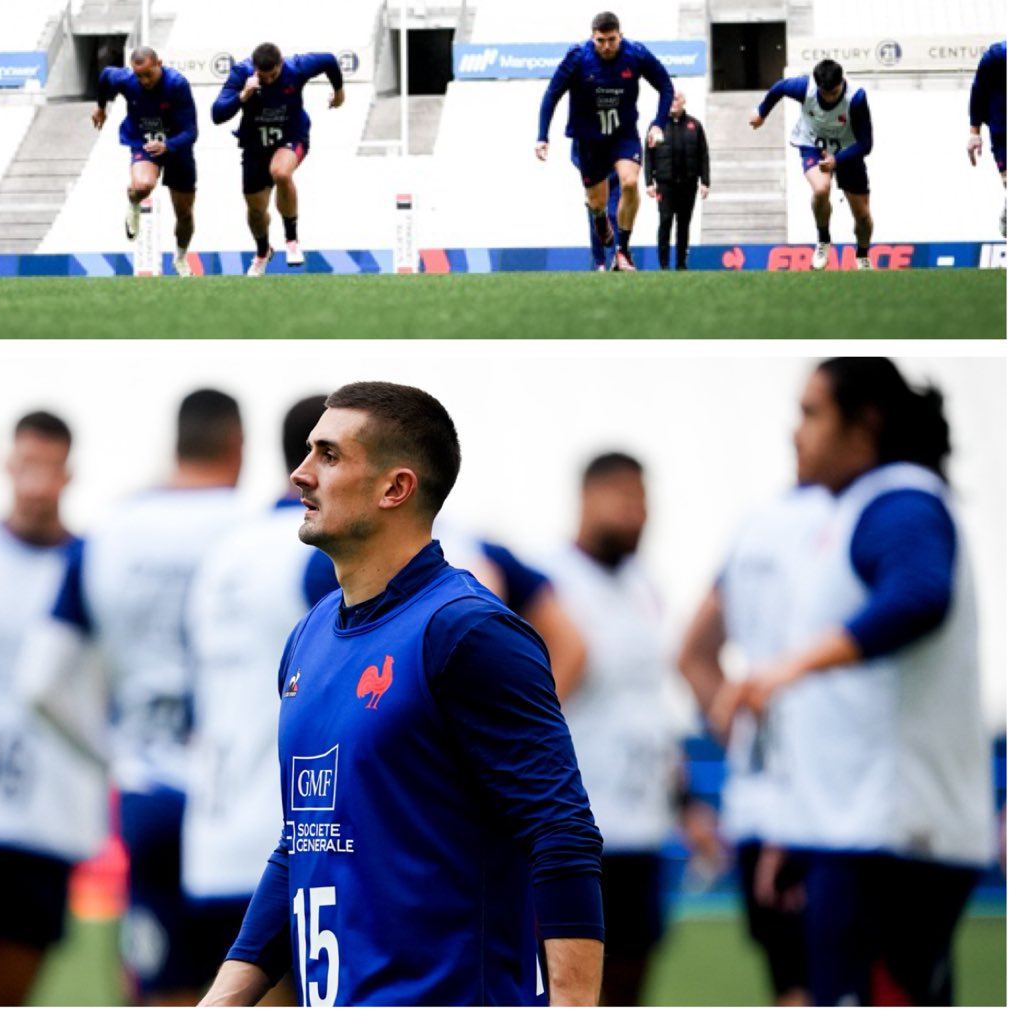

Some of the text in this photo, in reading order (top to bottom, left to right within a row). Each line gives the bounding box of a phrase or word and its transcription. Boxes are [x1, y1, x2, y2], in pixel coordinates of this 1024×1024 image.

[801, 48, 871, 61] CENTURY
[499, 55, 564, 73] Manpow
[298, 769, 333, 798] GMF
[297, 823, 341, 837] SOCIETE
[296, 838, 355, 852] GENERALE
[293, 886, 340, 1007] 15
